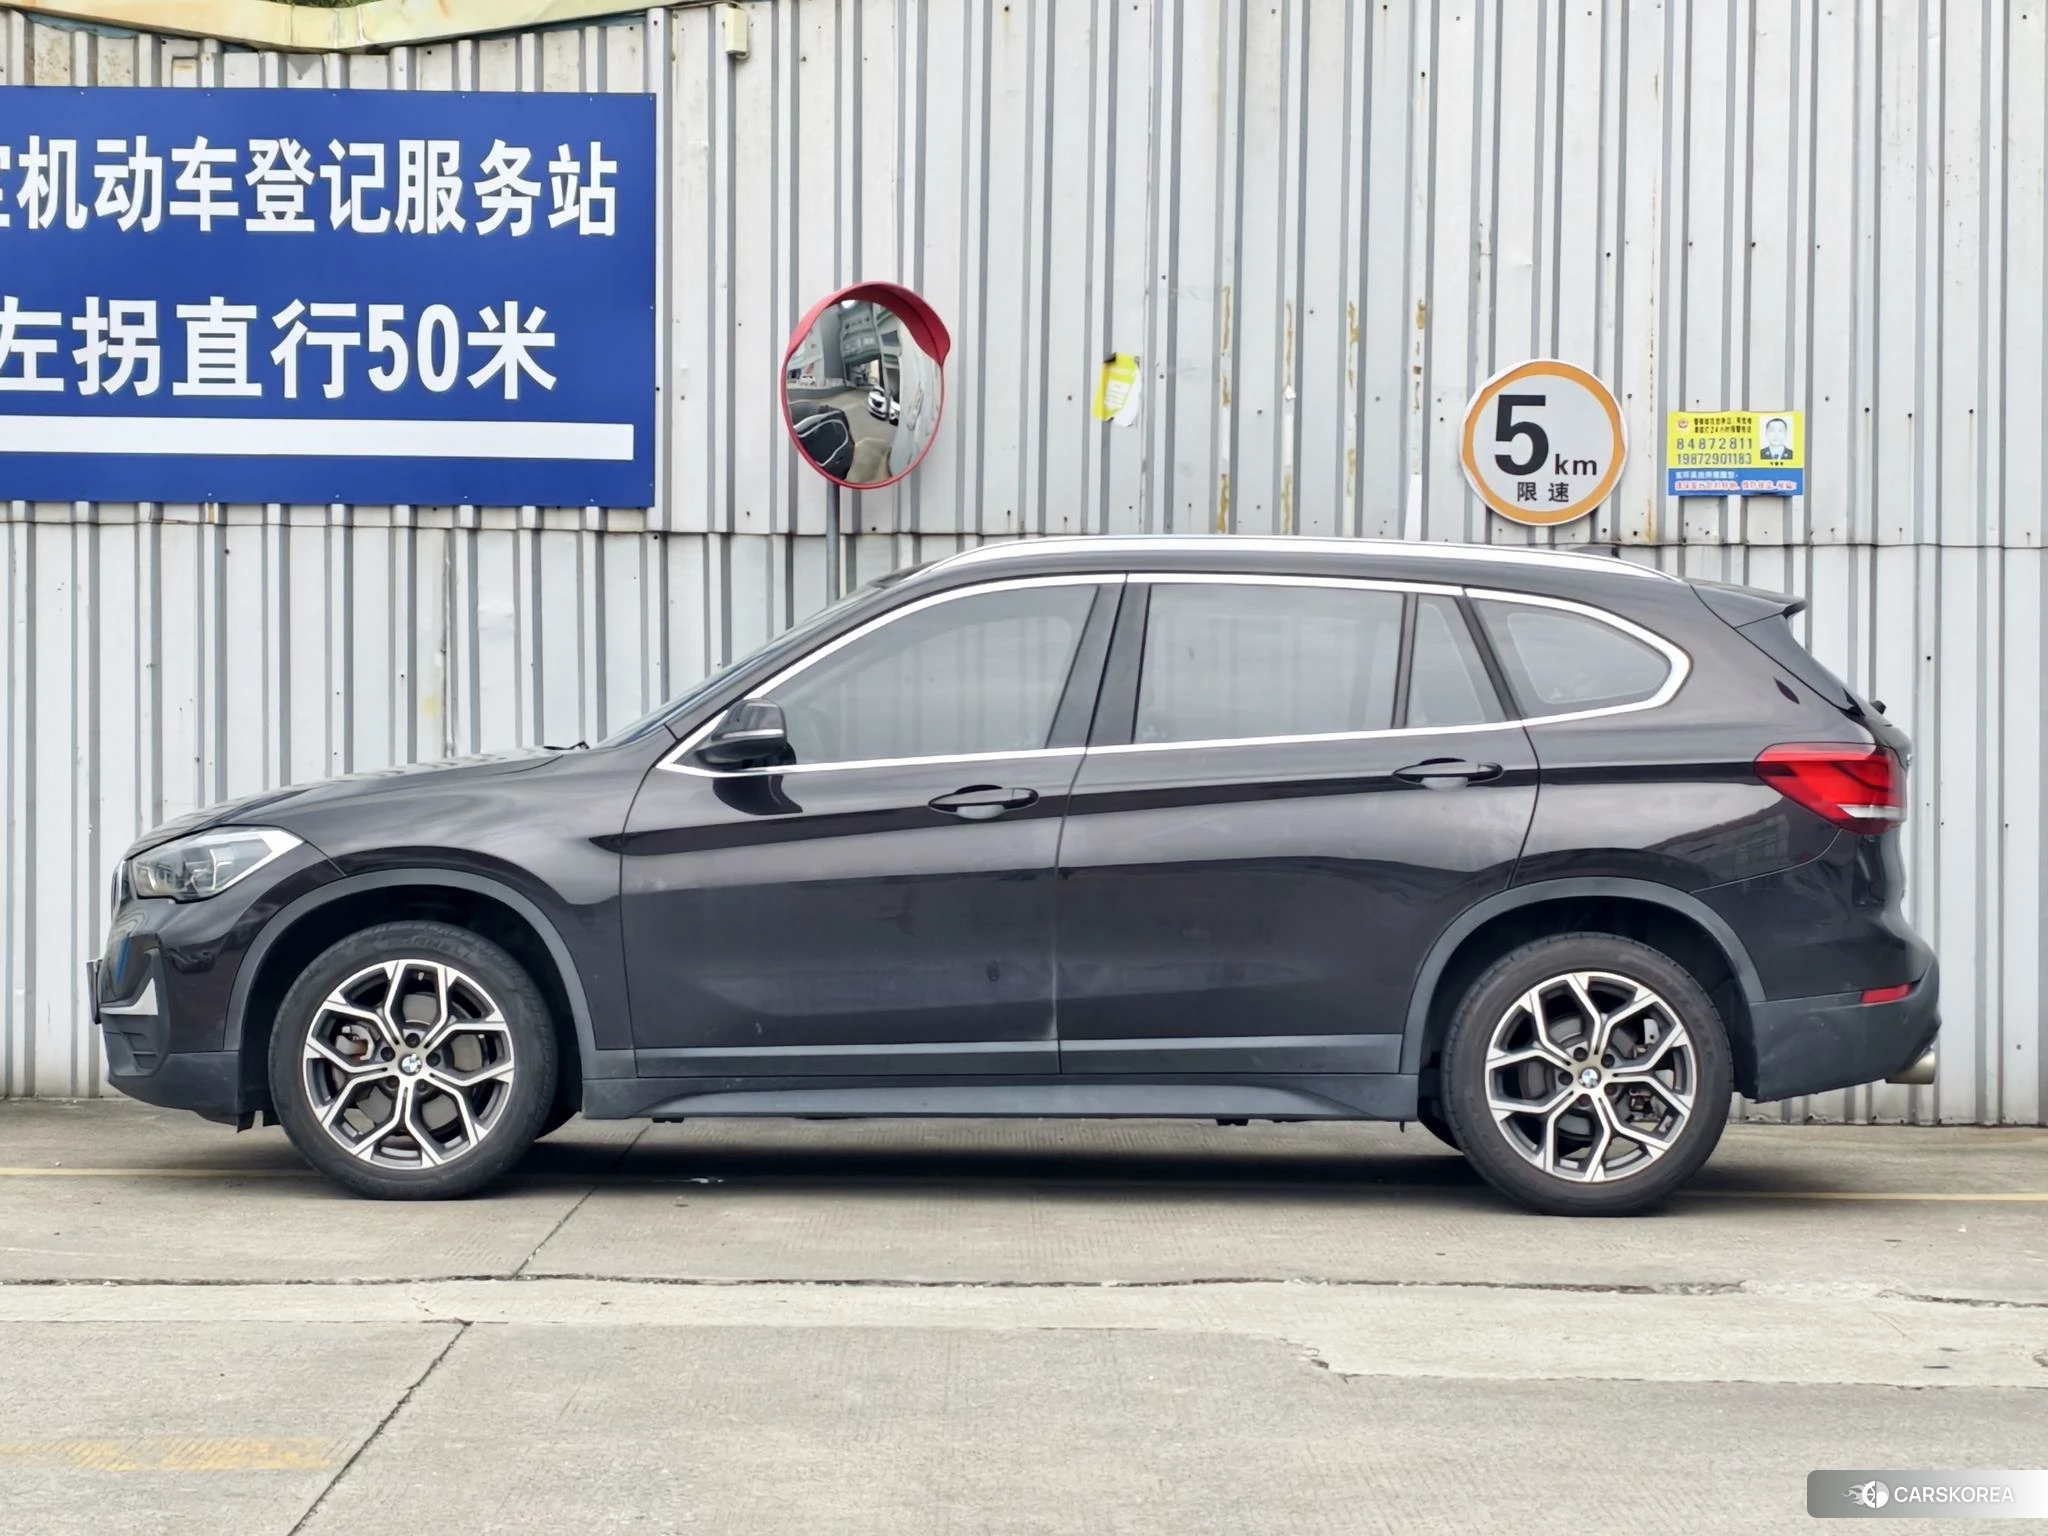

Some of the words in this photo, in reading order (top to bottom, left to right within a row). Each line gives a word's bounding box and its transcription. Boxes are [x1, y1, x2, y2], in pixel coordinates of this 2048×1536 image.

[0, 296, 556, 399] 左拐直行50米
[1495, 395, 1549, 475] 5
[1555, 454, 1597, 475] km
[1676, 438, 1753, 450] 84872811
[1677, 453, 1752, 465] 19872901183
[1517, 482, 1569, 502] 限速
